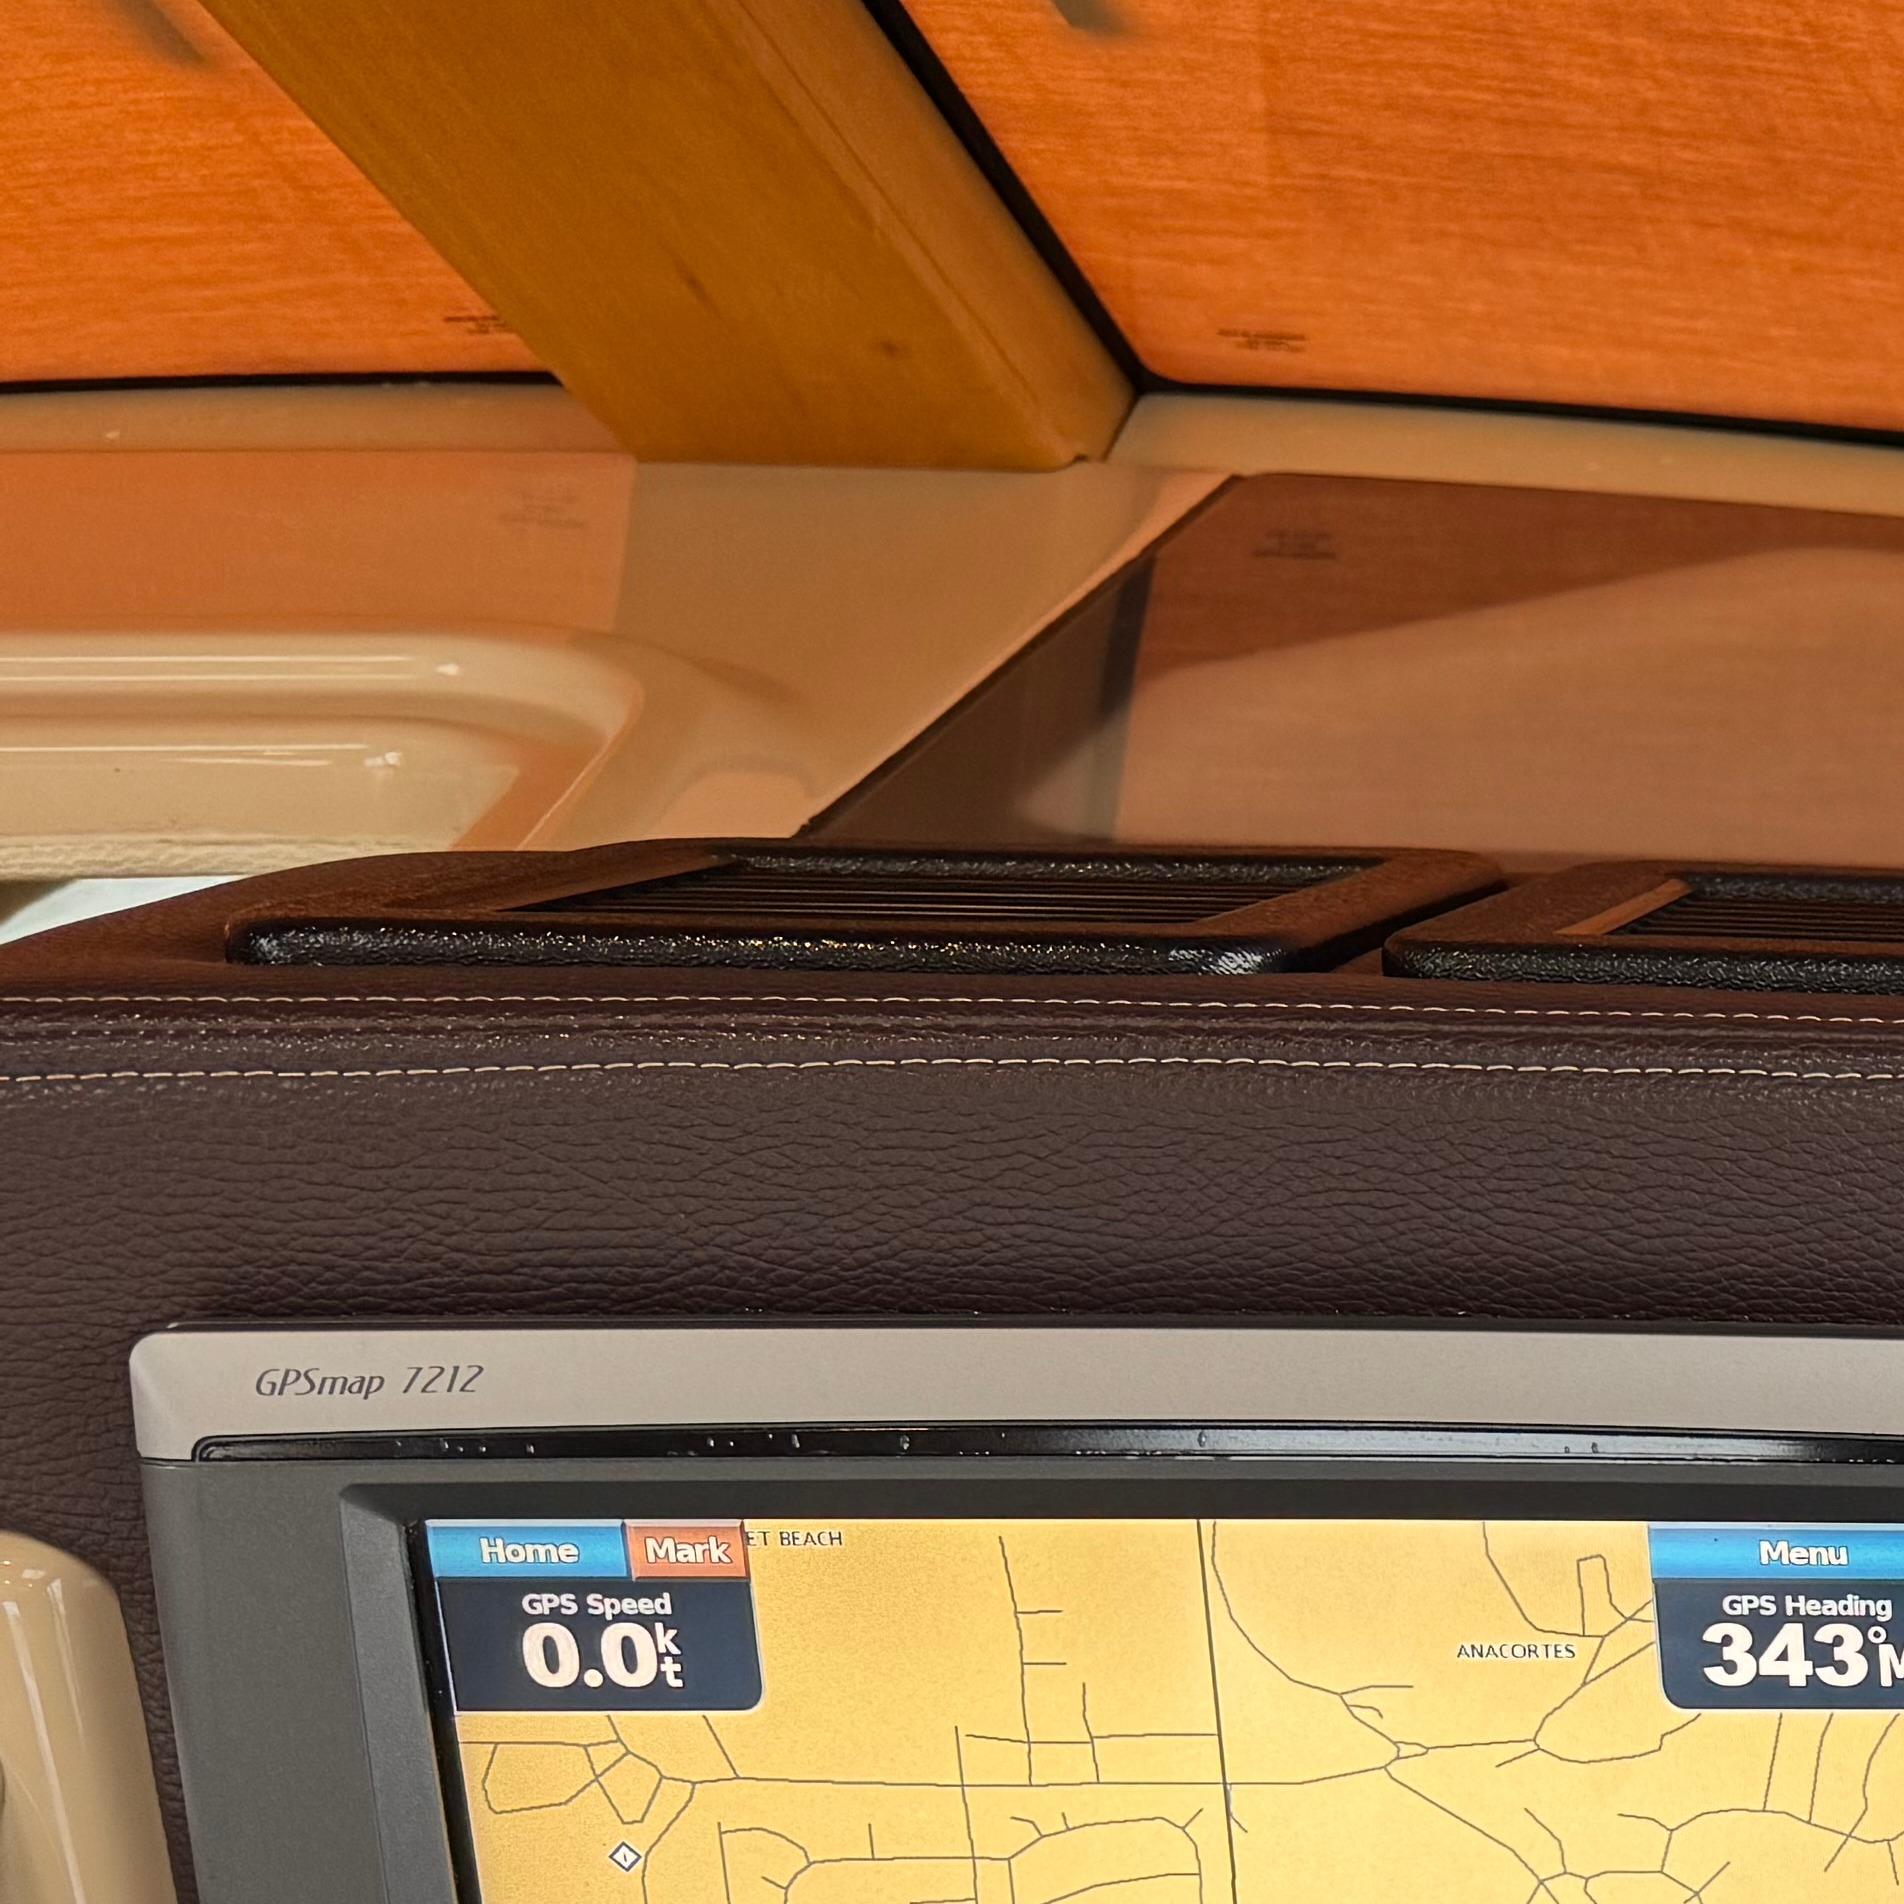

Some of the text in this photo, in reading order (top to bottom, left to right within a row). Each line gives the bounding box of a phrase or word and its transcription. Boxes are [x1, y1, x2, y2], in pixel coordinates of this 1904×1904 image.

[256, 1365, 485, 1401] GPSmap 7212
[481, 1537, 580, 1565] Home
[645, 1537, 732, 1565] Mark
[779, 1531, 843, 1546] BEACH
[1759, 1540, 1849, 1567] Menu
[522, 1593, 672, 1619] GPS Speed
[1722, 1594, 1893, 1623] GPS Heading
[1457, 1642, 1576, 1661] ANACORTES
